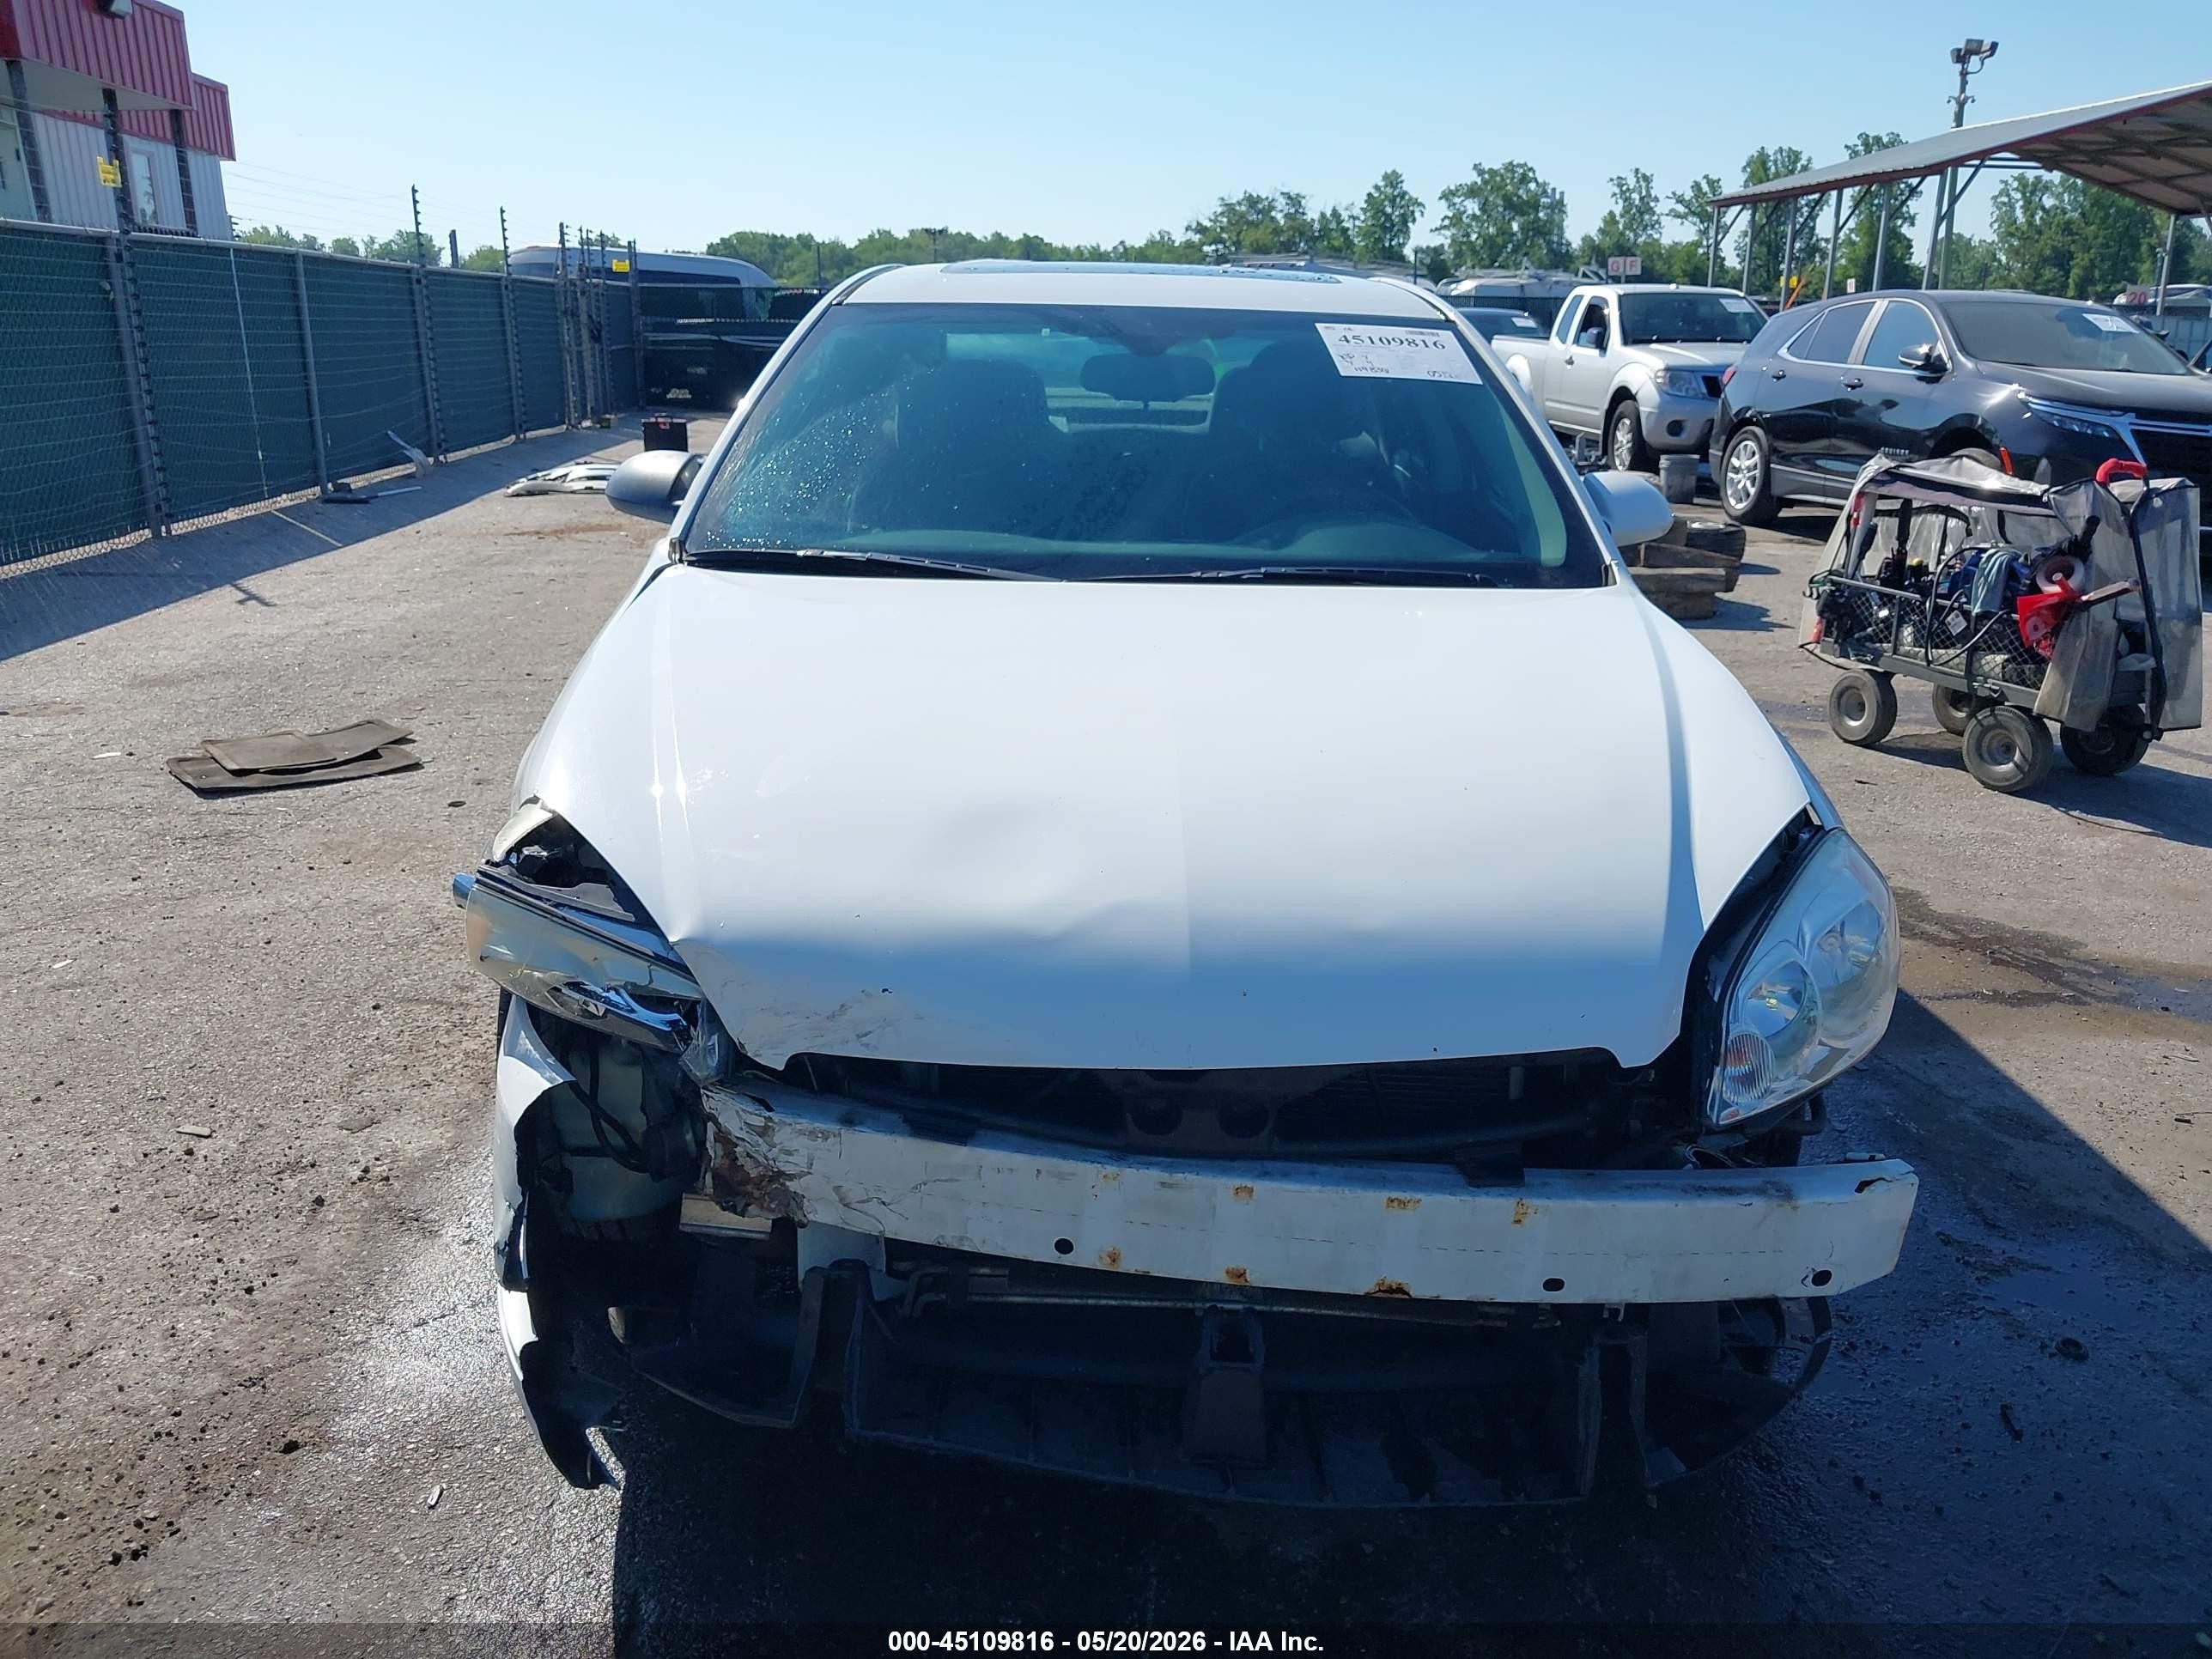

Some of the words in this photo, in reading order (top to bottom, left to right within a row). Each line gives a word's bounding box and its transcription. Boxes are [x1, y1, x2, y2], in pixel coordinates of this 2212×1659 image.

[1610, 259, 1620, 272] G
[1628, 259, 1637, 272] F
[1338, 334, 1446, 350] 45109816
